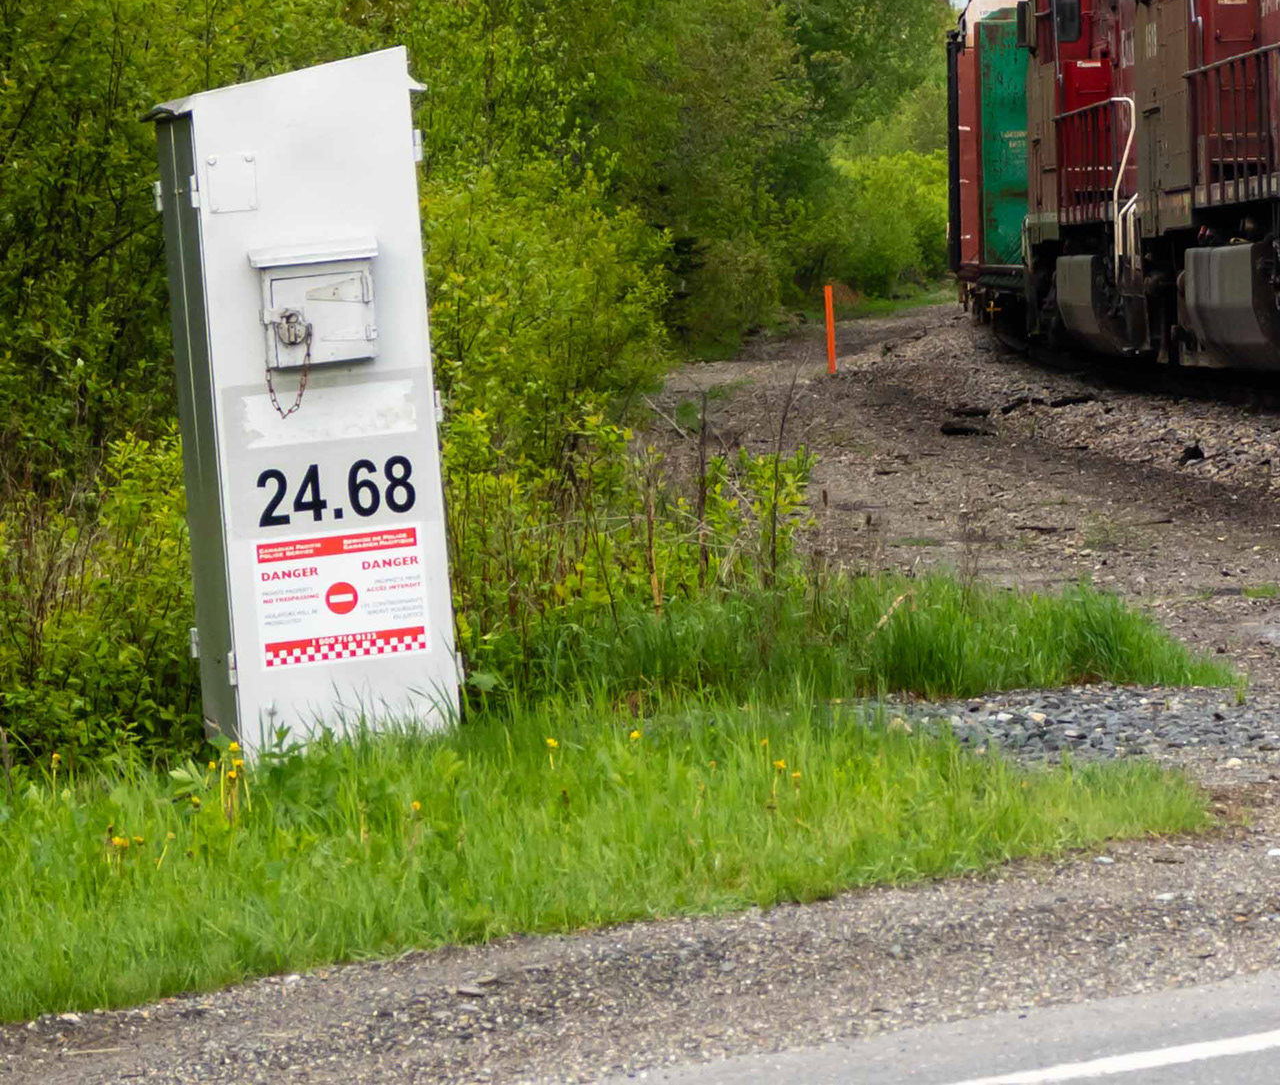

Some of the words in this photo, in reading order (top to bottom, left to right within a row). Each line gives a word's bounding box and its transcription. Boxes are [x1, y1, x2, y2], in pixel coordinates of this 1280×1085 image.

[256, 455, 416, 527] 24.68
[361, 555, 419, 571] DANGER
[261, 566, 318, 582] DANGER
